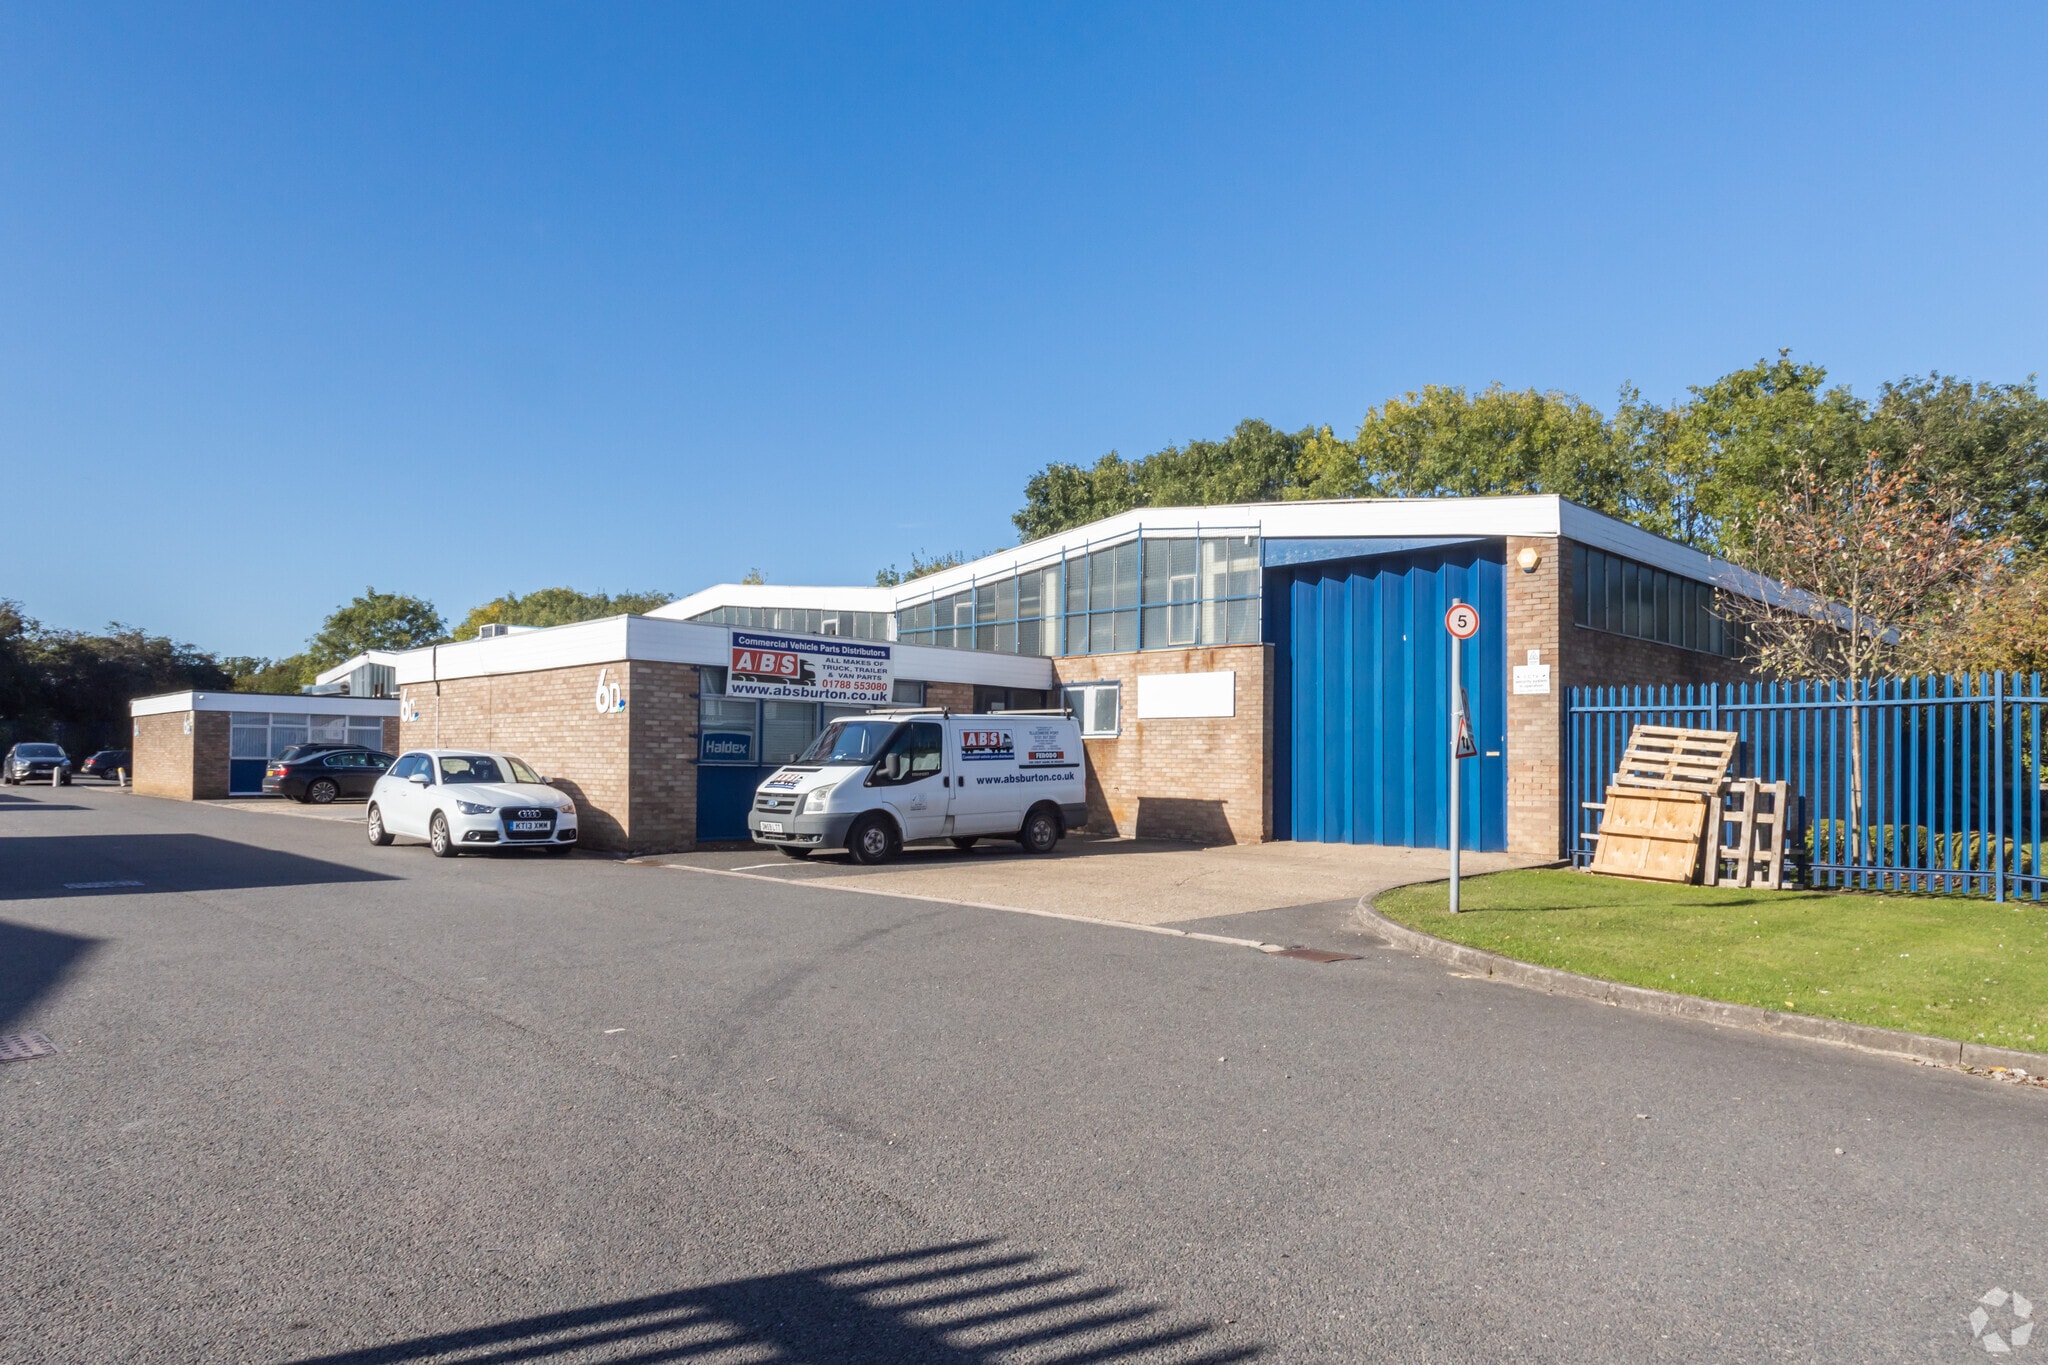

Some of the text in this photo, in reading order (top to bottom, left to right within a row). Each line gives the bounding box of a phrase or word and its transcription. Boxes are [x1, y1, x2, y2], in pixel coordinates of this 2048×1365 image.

[1458, 614, 1467, 628] 5
[738, 636, 886, 656] Commercial Vehicle Parts Distributors
[736, 652, 795, 674] ABS
[595, 668, 621, 714] 6D
[732, 684, 888, 702] www.absburton.co.uk
[822, 679, 888, 691] 01788 553080
[401, 689, 416, 722] 6C
[706, 740, 747, 754] Haldex
[966, 732, 998, 746] ABS
[976, 772, 1074, 784] www.absburton.co.uk
